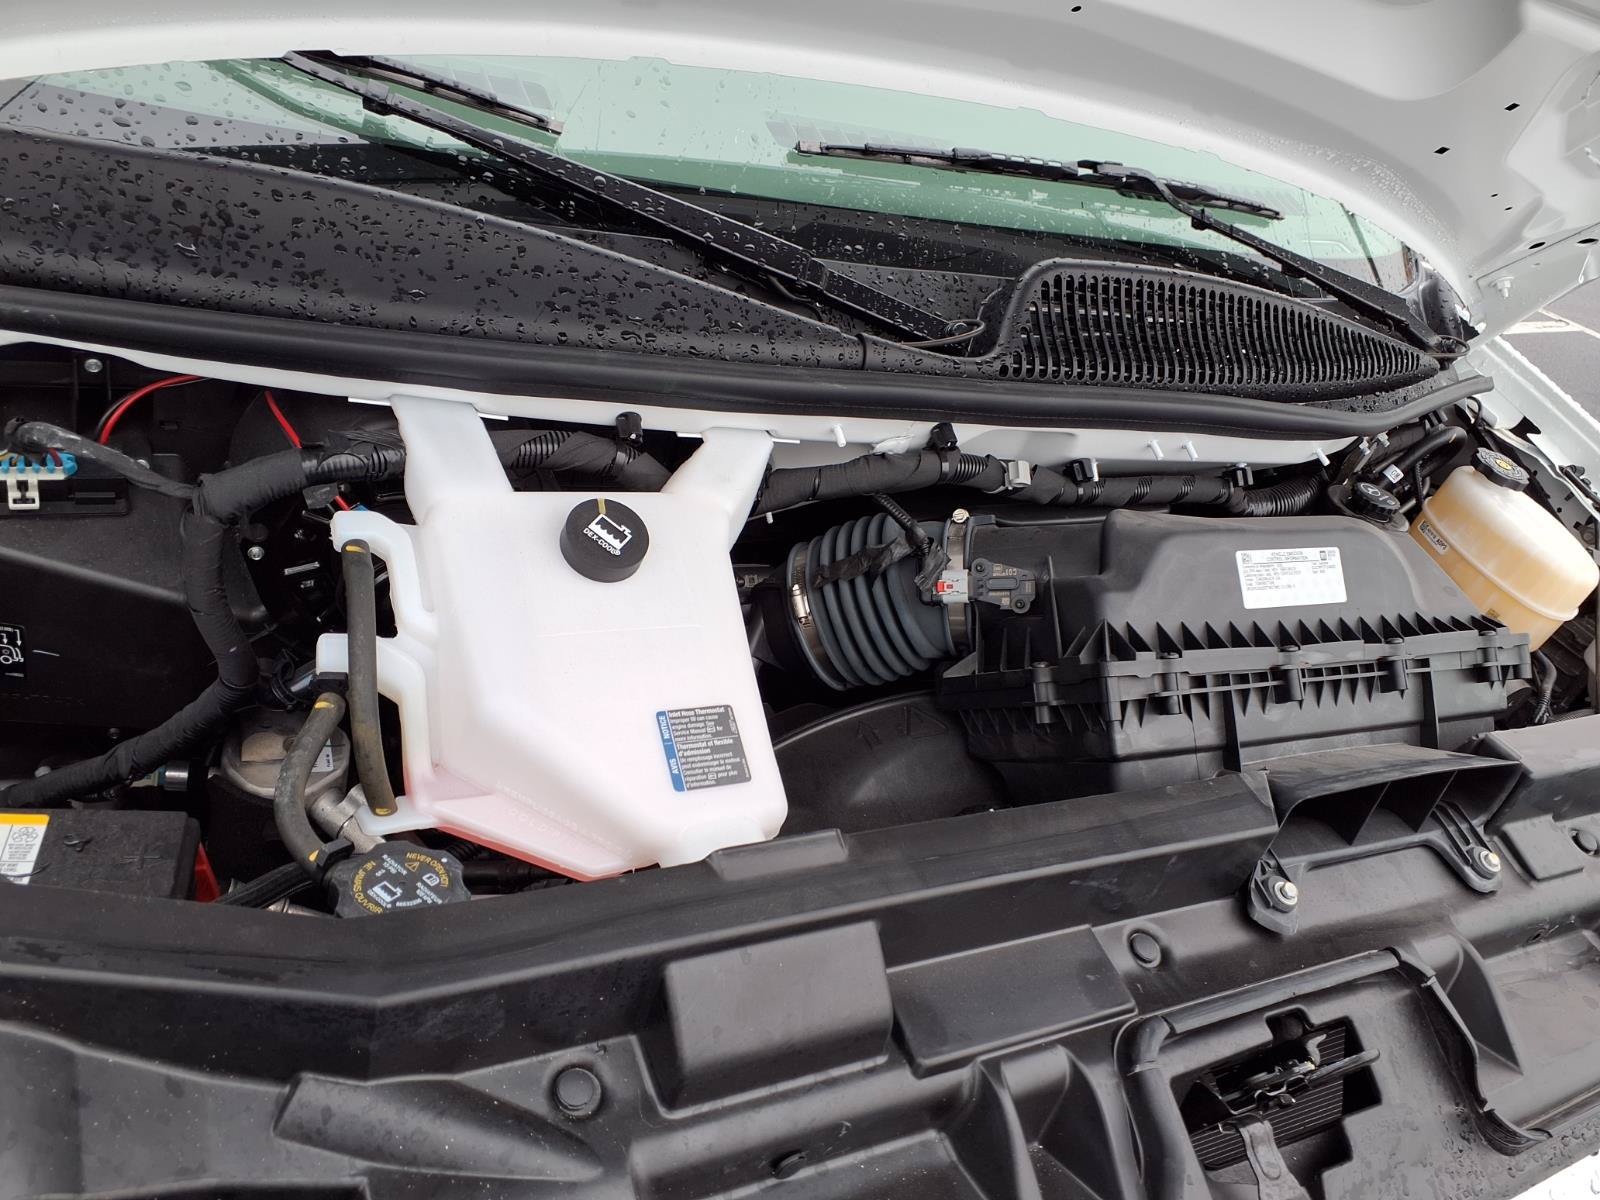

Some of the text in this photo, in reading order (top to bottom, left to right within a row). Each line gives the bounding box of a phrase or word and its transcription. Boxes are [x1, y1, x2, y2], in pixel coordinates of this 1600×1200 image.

[695, 706, 725, 715] Thermostat
[659, 715, 670, 739] NOTICE
[677, 741, 707, 750] Thermostat
[670, 758, 680, 774] AVIS
[406, 852, 431, 864] NEVER
[430, 860, 446, 875] OPEN
